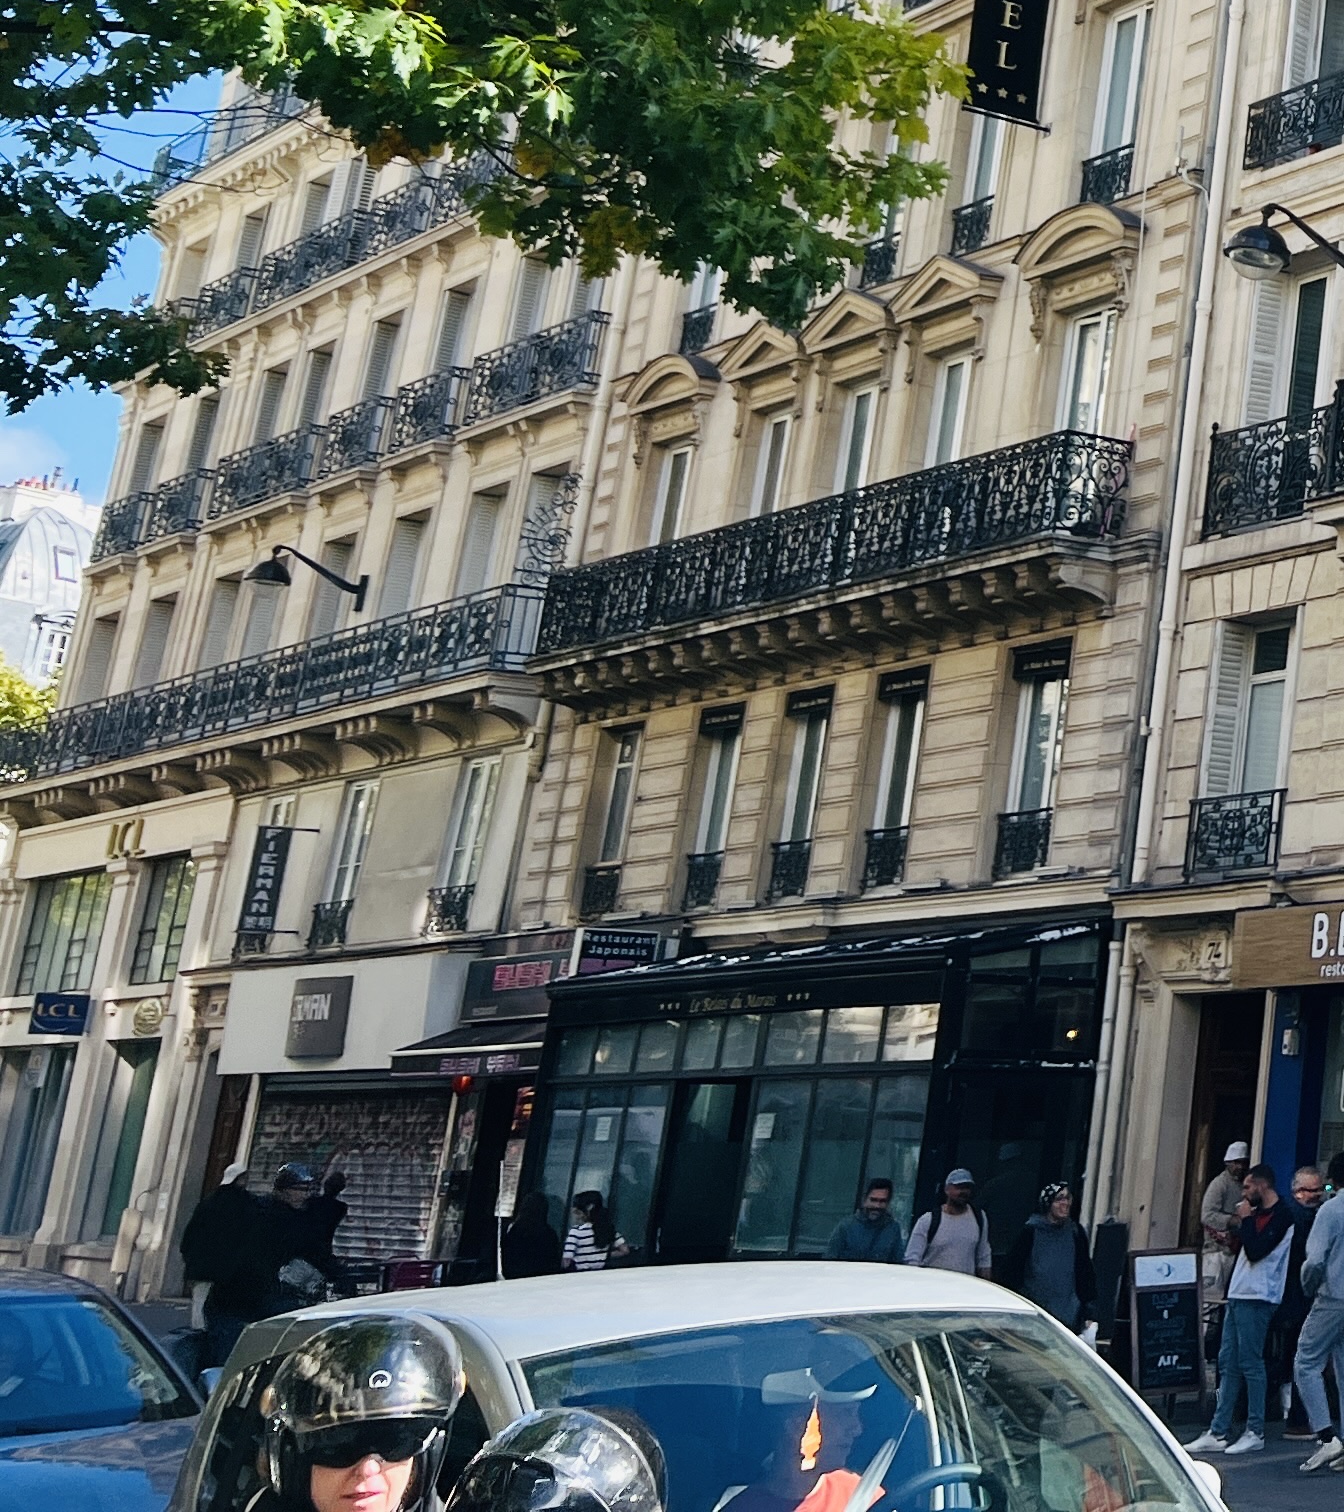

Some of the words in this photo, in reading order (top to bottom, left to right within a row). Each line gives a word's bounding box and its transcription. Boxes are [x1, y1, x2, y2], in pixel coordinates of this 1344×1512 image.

[583, 932, 656, 945] Restaurant
[588, 946, 648, 957] Japonais
[36, 1002, 81, 1018] LCL
